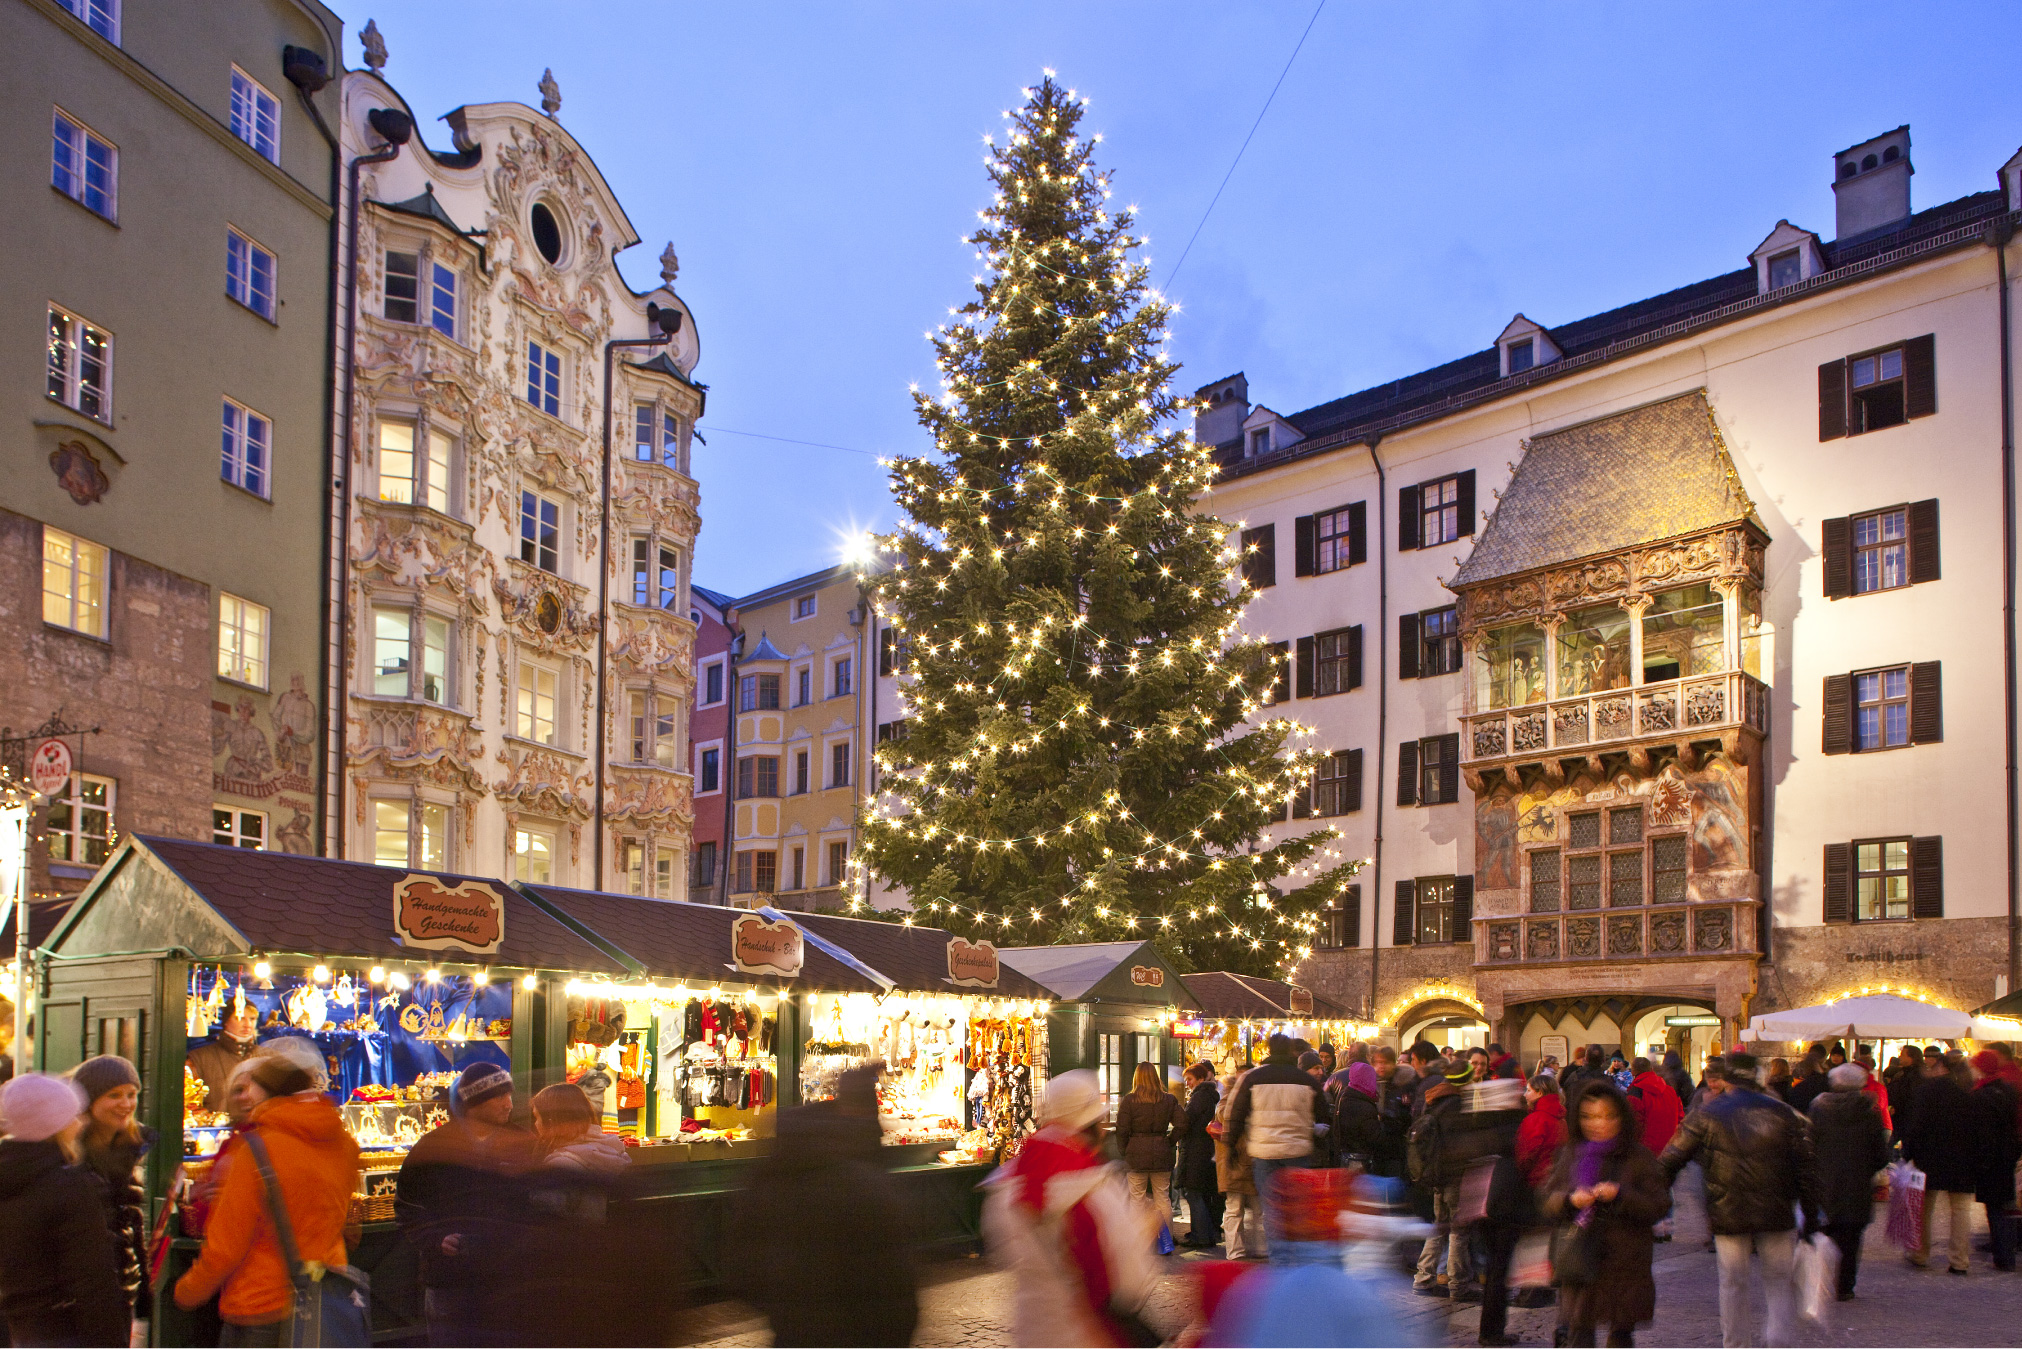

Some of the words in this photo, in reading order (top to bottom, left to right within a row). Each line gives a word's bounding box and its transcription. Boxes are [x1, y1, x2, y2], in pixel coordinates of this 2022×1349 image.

[36, 761, 67, 779] HANDL
[410, 897, 489, 918] Handgemachte
[420, 915, 480, 934] Geschenke
[741, 937, 776, 953] Handschuh
